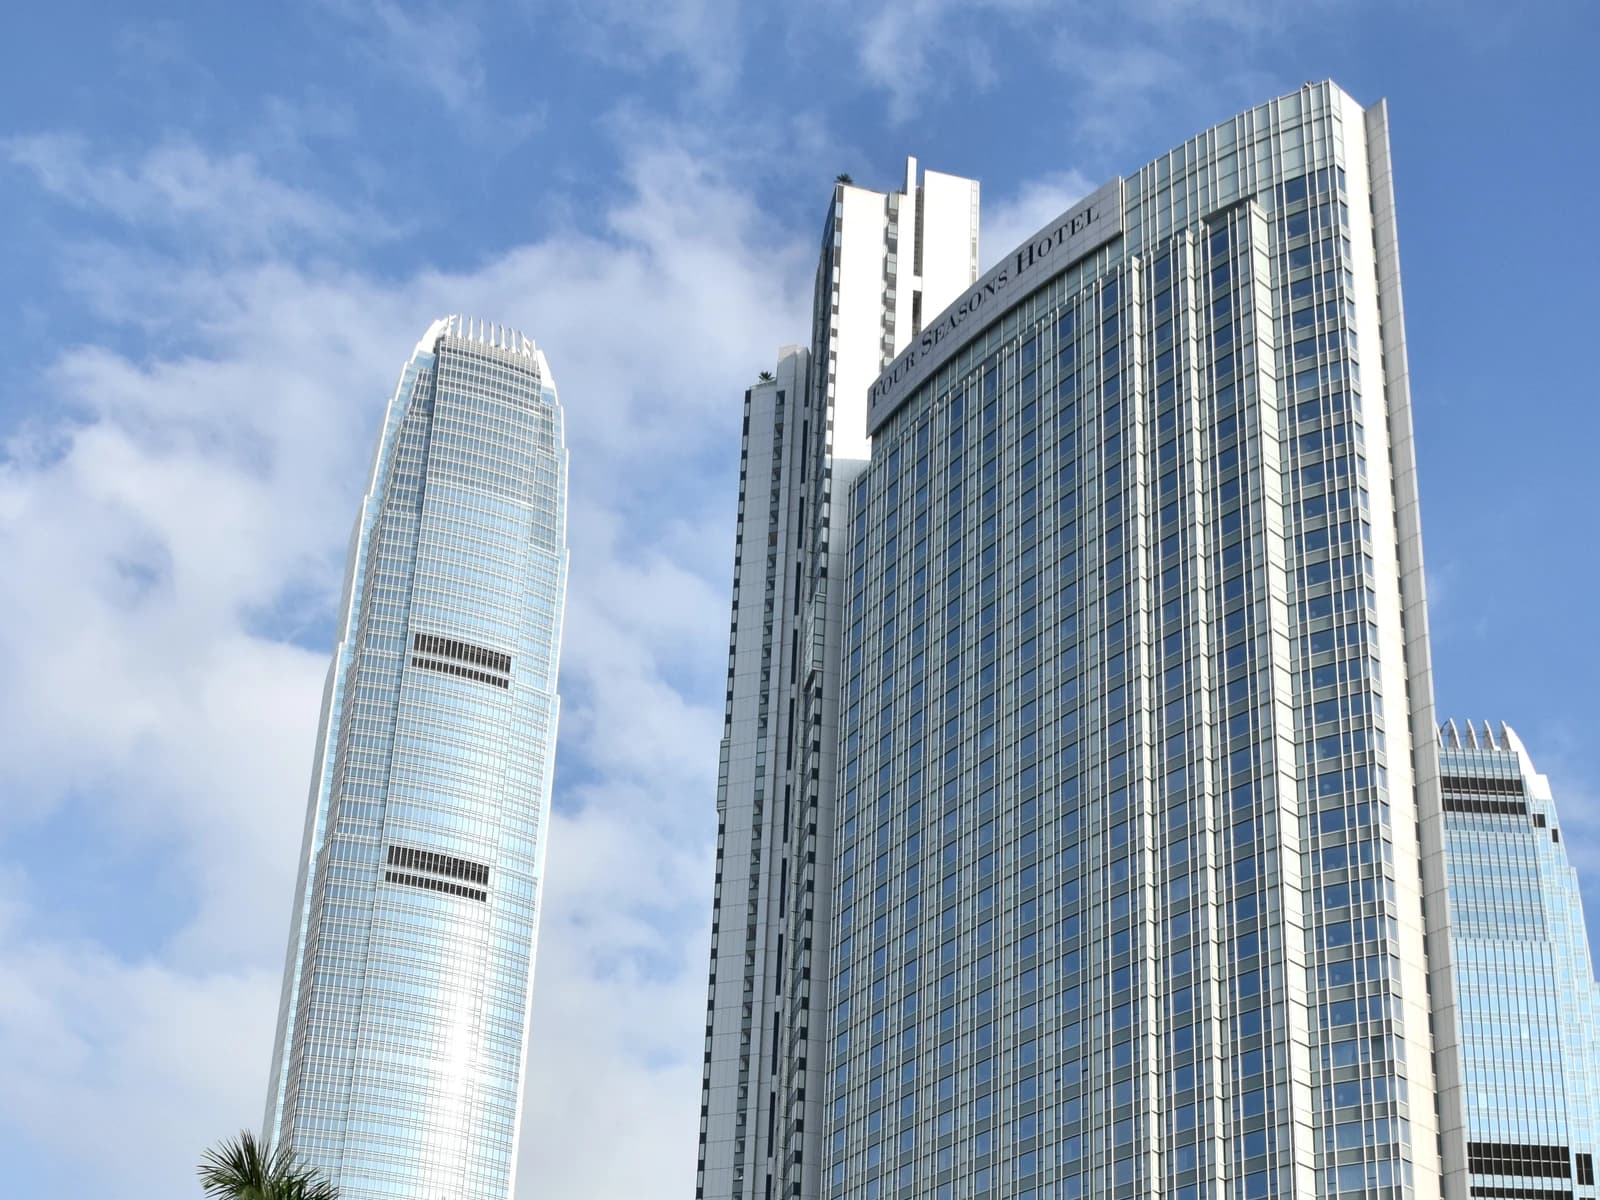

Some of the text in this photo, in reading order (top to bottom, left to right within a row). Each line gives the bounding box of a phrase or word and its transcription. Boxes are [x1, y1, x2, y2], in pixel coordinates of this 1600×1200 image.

[871, 206, 1100, 409] FOUR SEASONS HOTEL
